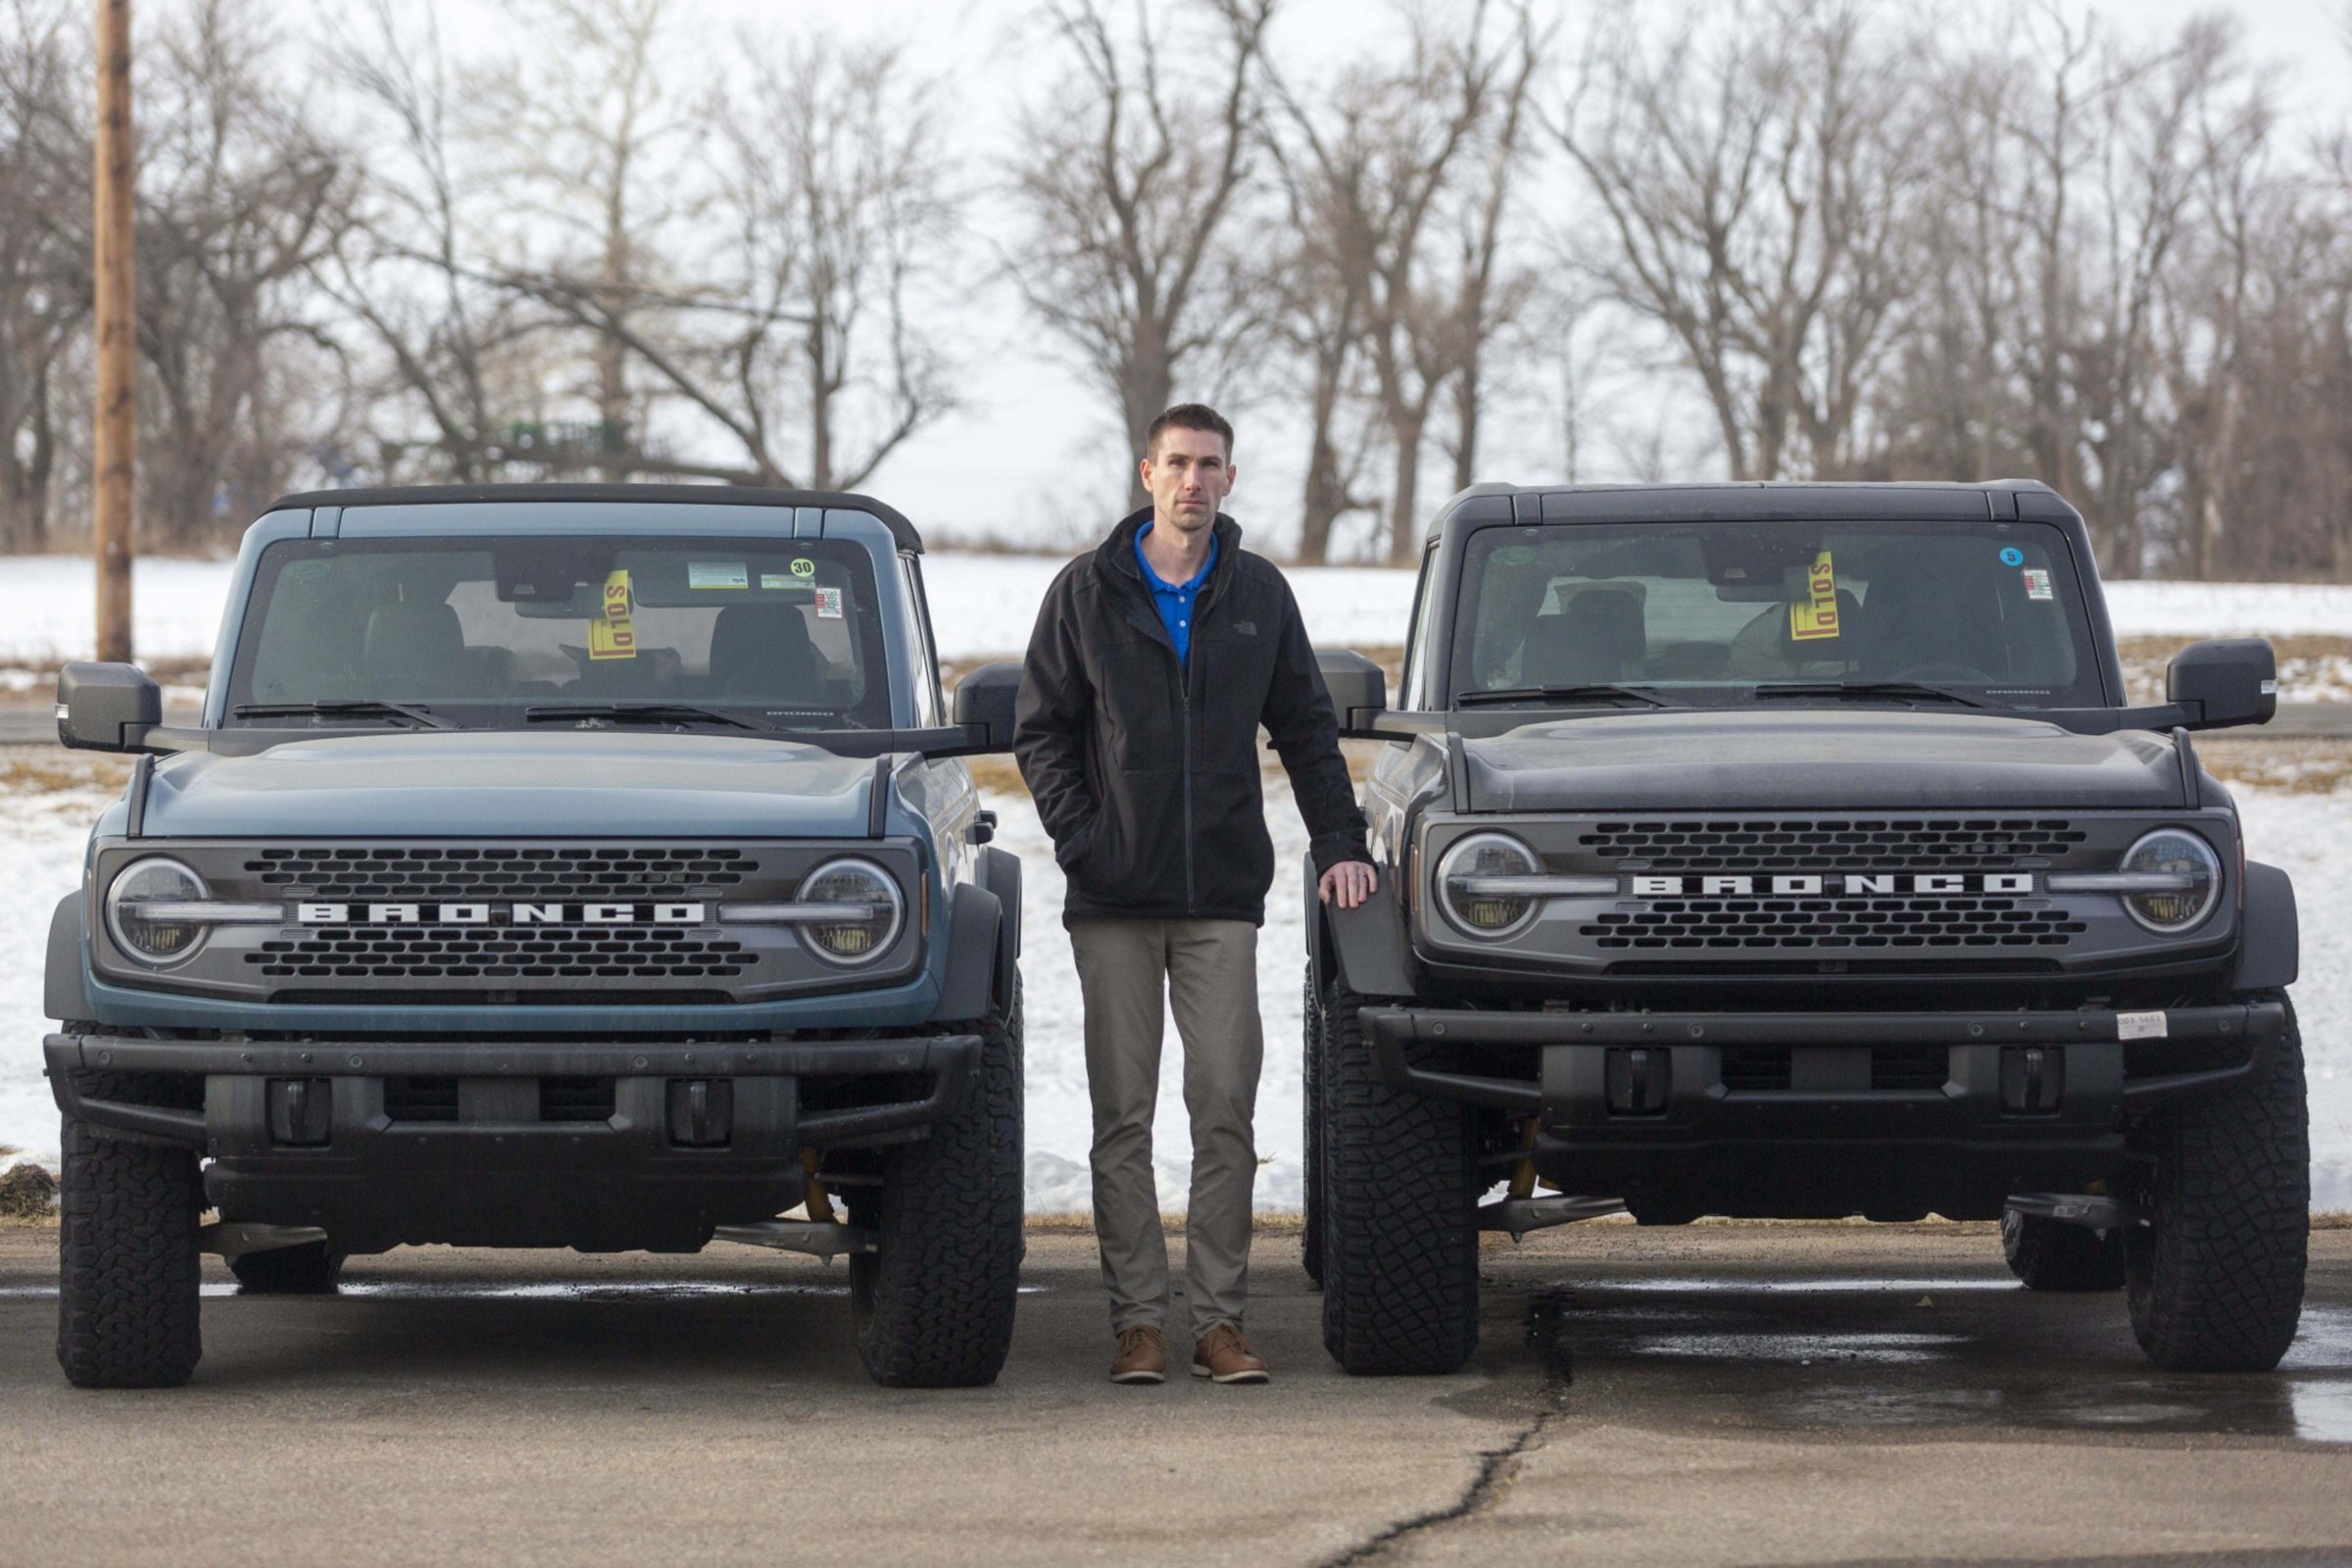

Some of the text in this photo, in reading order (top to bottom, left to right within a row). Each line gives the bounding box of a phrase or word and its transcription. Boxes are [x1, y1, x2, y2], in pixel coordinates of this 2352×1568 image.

[2006, 551, 2016, 562] 5
[793, 562, 811, 573] 30
[1810, 563, 1837, 625] SOLD
[606, 584, 633, 647] SOLD
[1633, 874, 2034, 895] BRONCO
[298, 904, 705, 922] BRONCO
